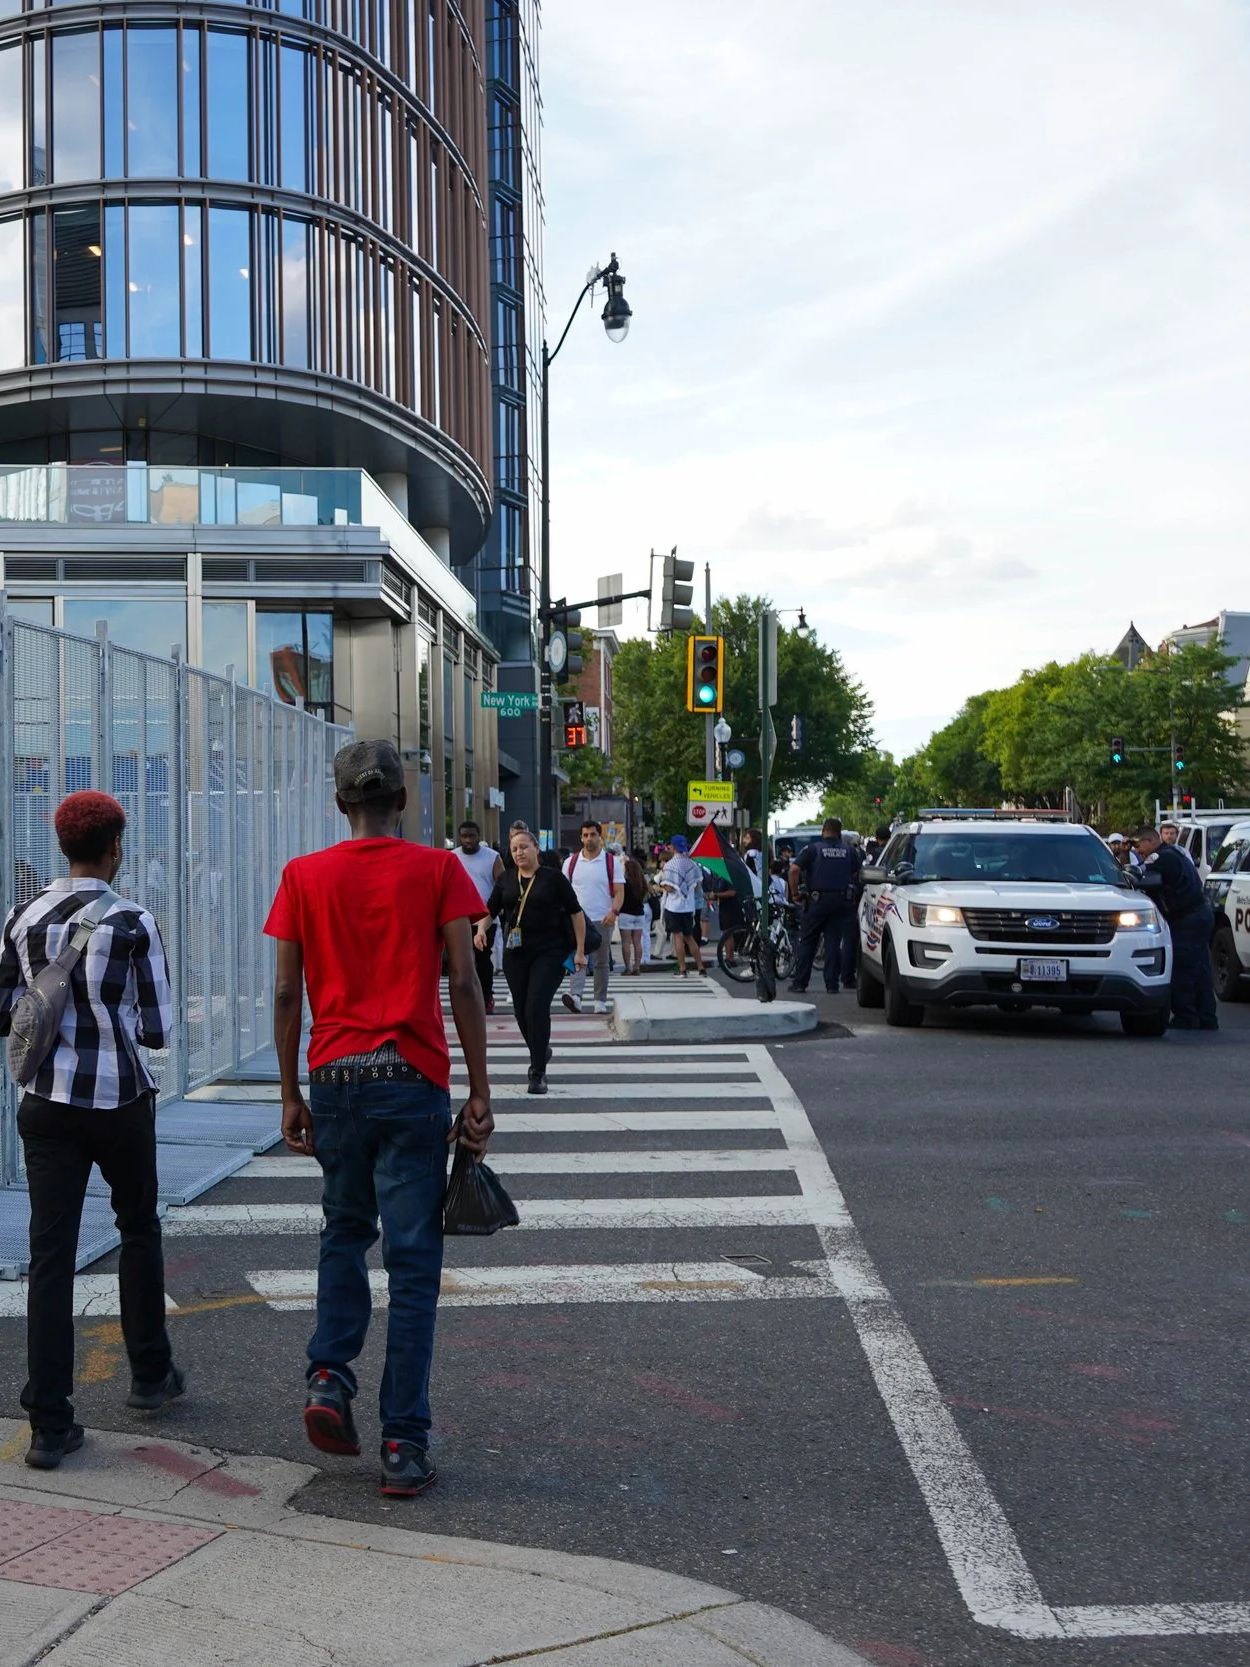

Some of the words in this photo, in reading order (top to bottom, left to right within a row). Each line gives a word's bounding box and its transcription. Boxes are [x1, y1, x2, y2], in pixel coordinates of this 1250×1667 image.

[483, 694, 505, 706] New
[508, 695, 530, 707] York
[500, 707, 520, 716] 600
[567, 727, 585, 745] 37
[1032, 919, 1052, 928] Ford
